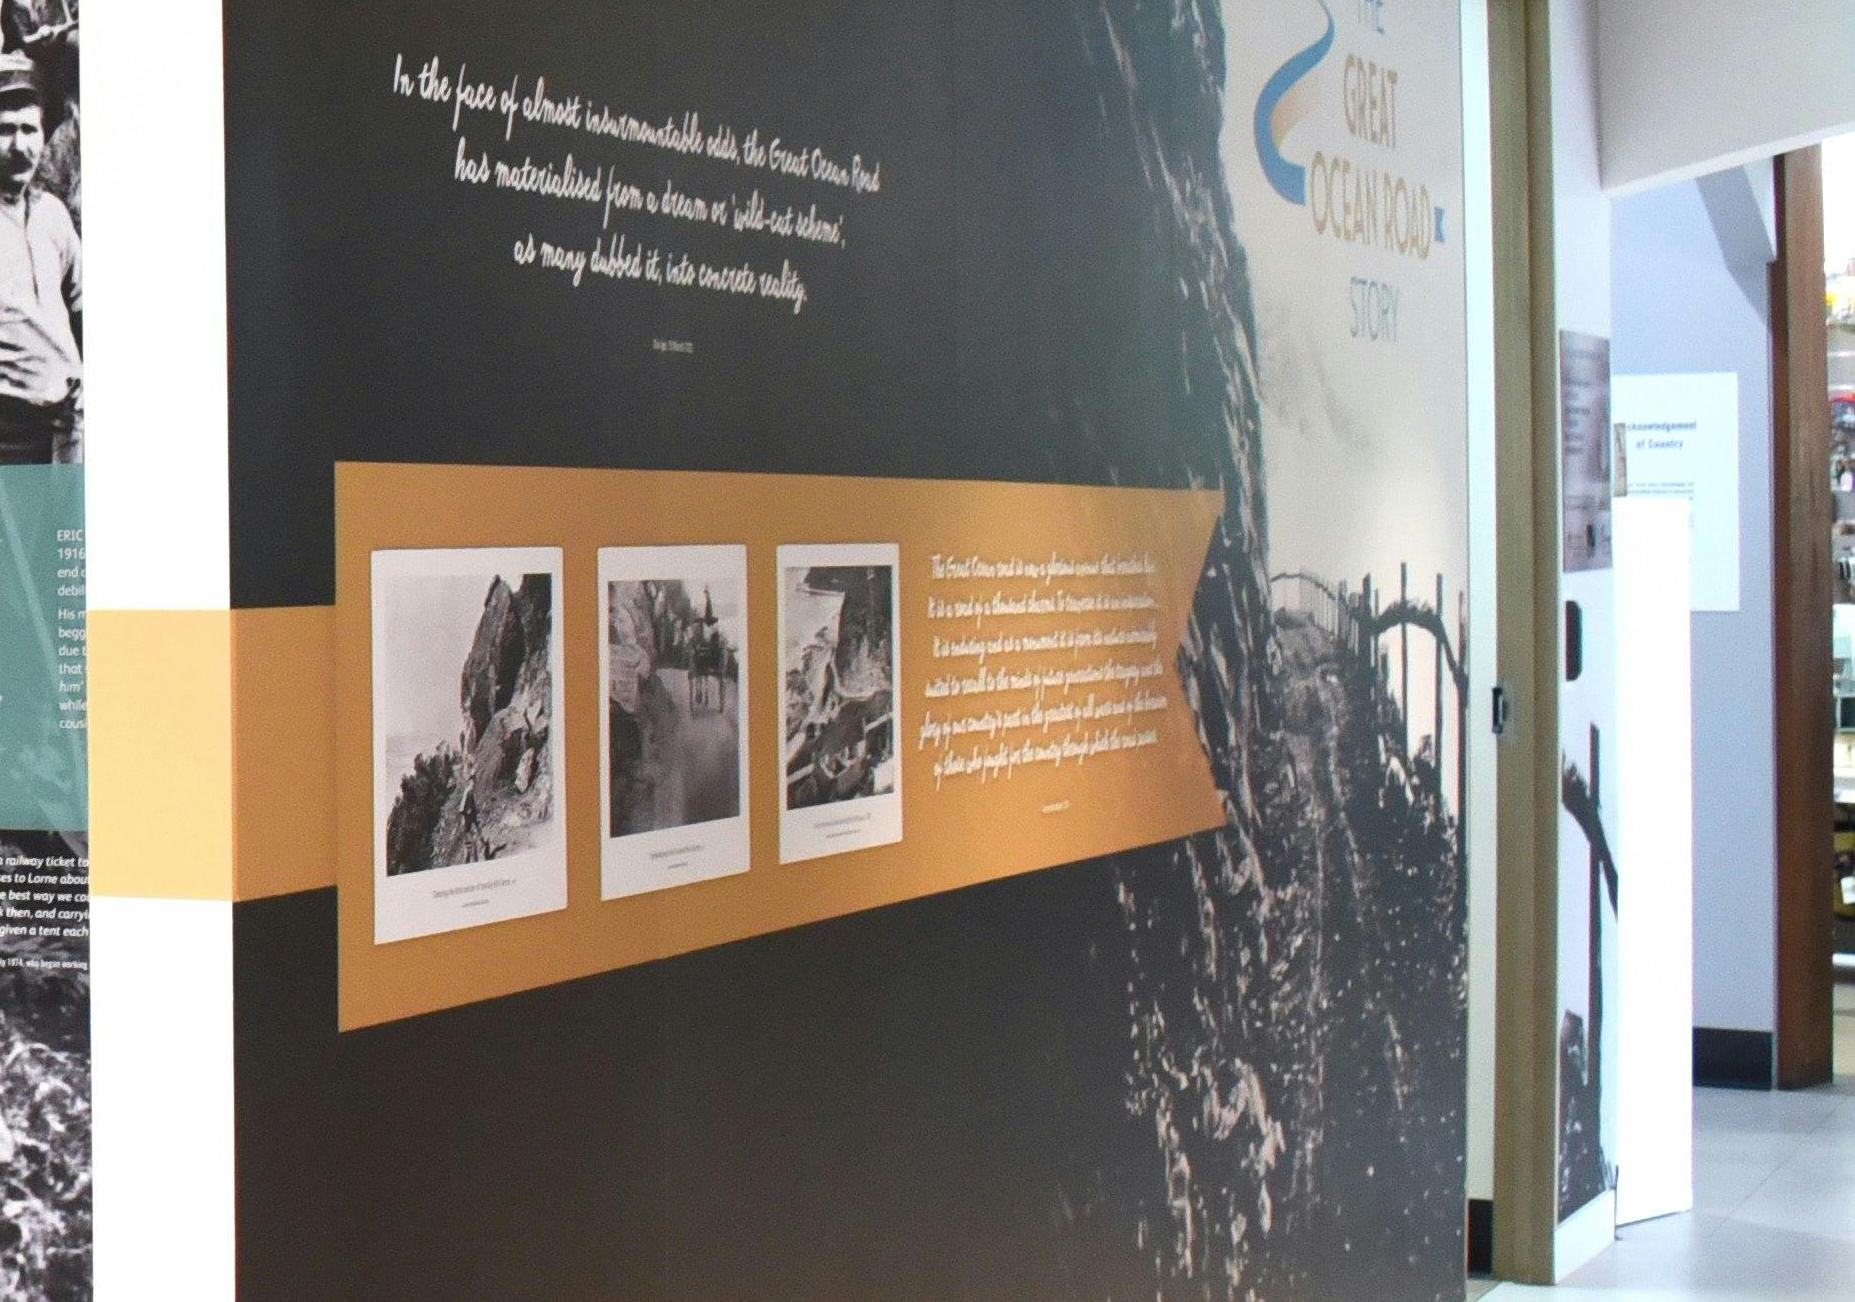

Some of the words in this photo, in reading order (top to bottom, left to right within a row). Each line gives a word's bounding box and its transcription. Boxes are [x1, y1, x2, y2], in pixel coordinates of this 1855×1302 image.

[393, 53, 414, 97] In
[418, 55, 452, 102] the
[452, 63, 497, 132] face
[500, 74, 518, 141] of
[522, 76, 582, 129] almost
[585, 101, 704, 154] insurmountable
[706, 125, 741, 165] odds,
[742, 128, 766, 168] the
[769, 137, 809, 177] Great
[811, 148, 850, 187] Ocean
[851, 154, 880, 194] Road
[1342, 53, 1398, 149] GREAT
[454, 136, 490, 184] has
[495, 153, 603, 202] materialised
[603, 165, 642, 230] from
[647, 191, 659, 214] a
[661, 179, 708, 221] dream
[712, 200, 727, 226] or
[1309, 150, 1379, 246] OCEAN
[1384, 172, 1431, 260] ROAD
[513, 232, 536, 264] as
[540, 241, 586, 287] many
[590, 233, 642, 278] dubbed
[645, 249, 662, 285] it,
[666, 252, 695, 286] into
[698, 262, 757, 294] concrete
[759, 258, 808, 315] reality.
[1349, 277, 1402, 343] STORY
[1626, 421, 1697, 432] cknowledgement
[1648, 438, 1684, 451] Country
